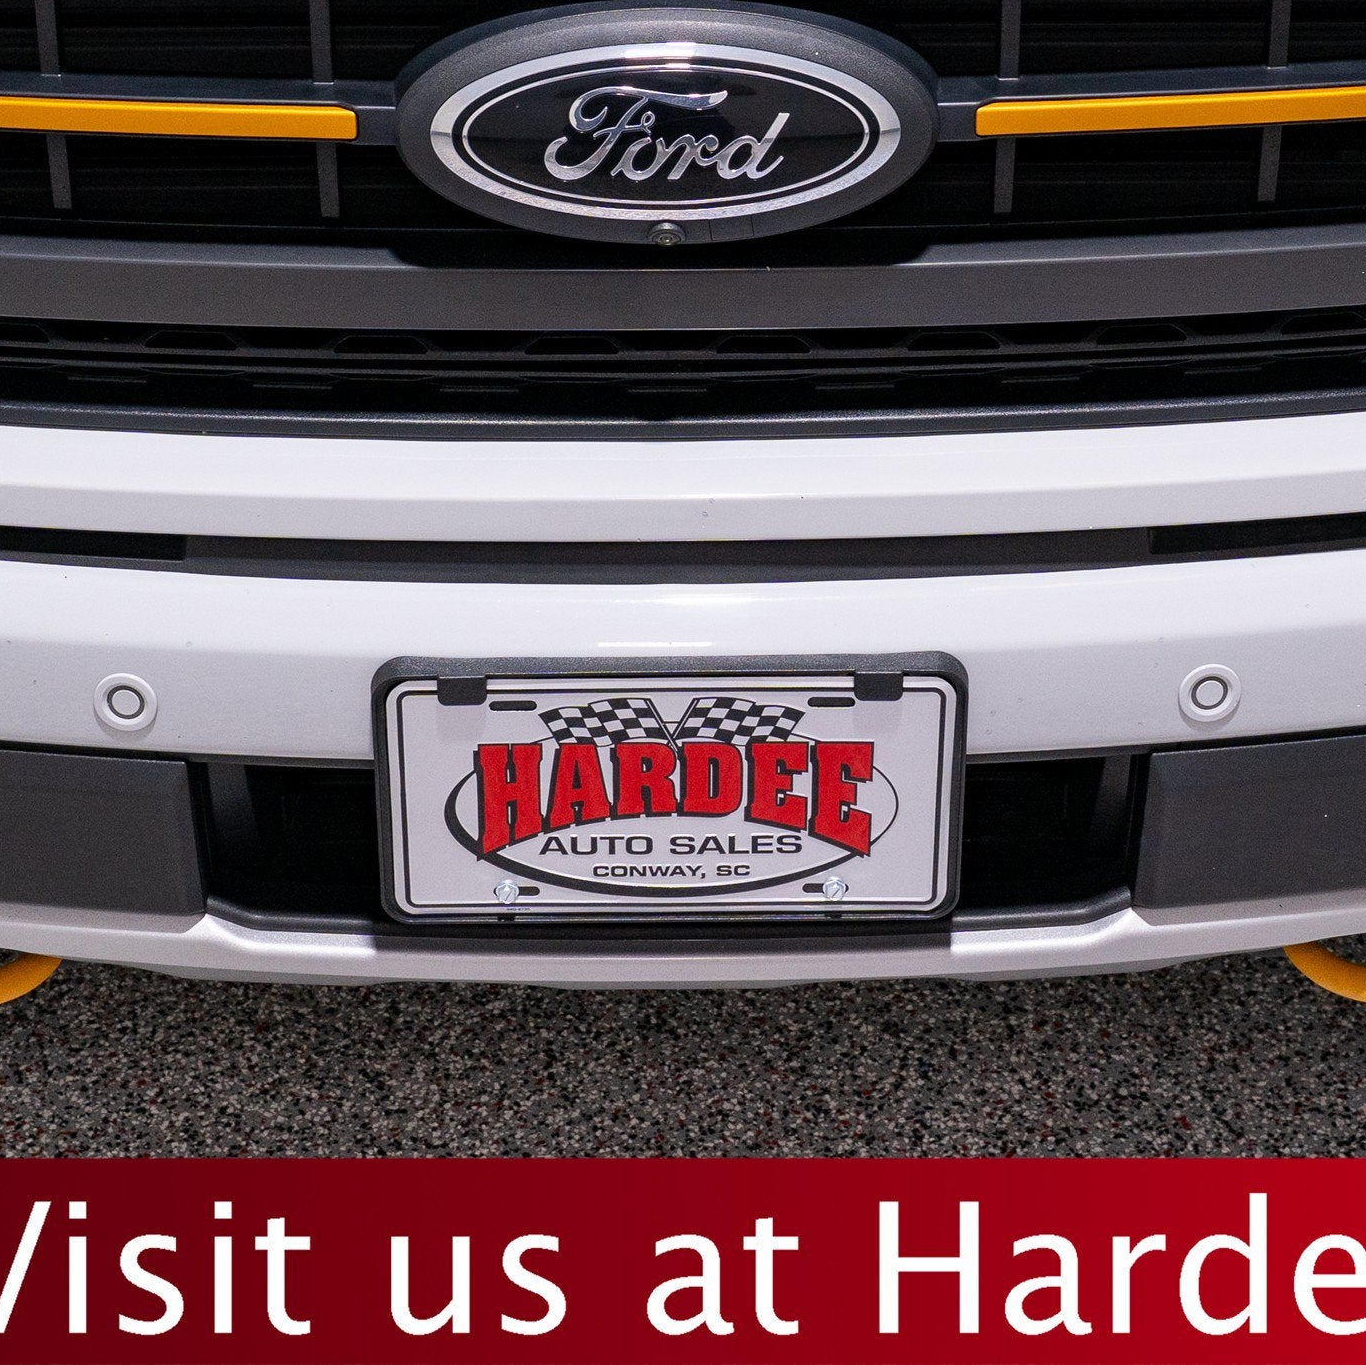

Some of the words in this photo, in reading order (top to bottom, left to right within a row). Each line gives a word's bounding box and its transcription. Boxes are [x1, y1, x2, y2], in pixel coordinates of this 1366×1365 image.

[544, 86, 790, 181] Ford
[473, 740, 874, 861] HARDEE
[538, 835, 654, 856] AUTO
[669, 834, 803, 855] SALES
[591, 863, 707, 880] CONWAY,
[716, 863, 751, 878] SC
